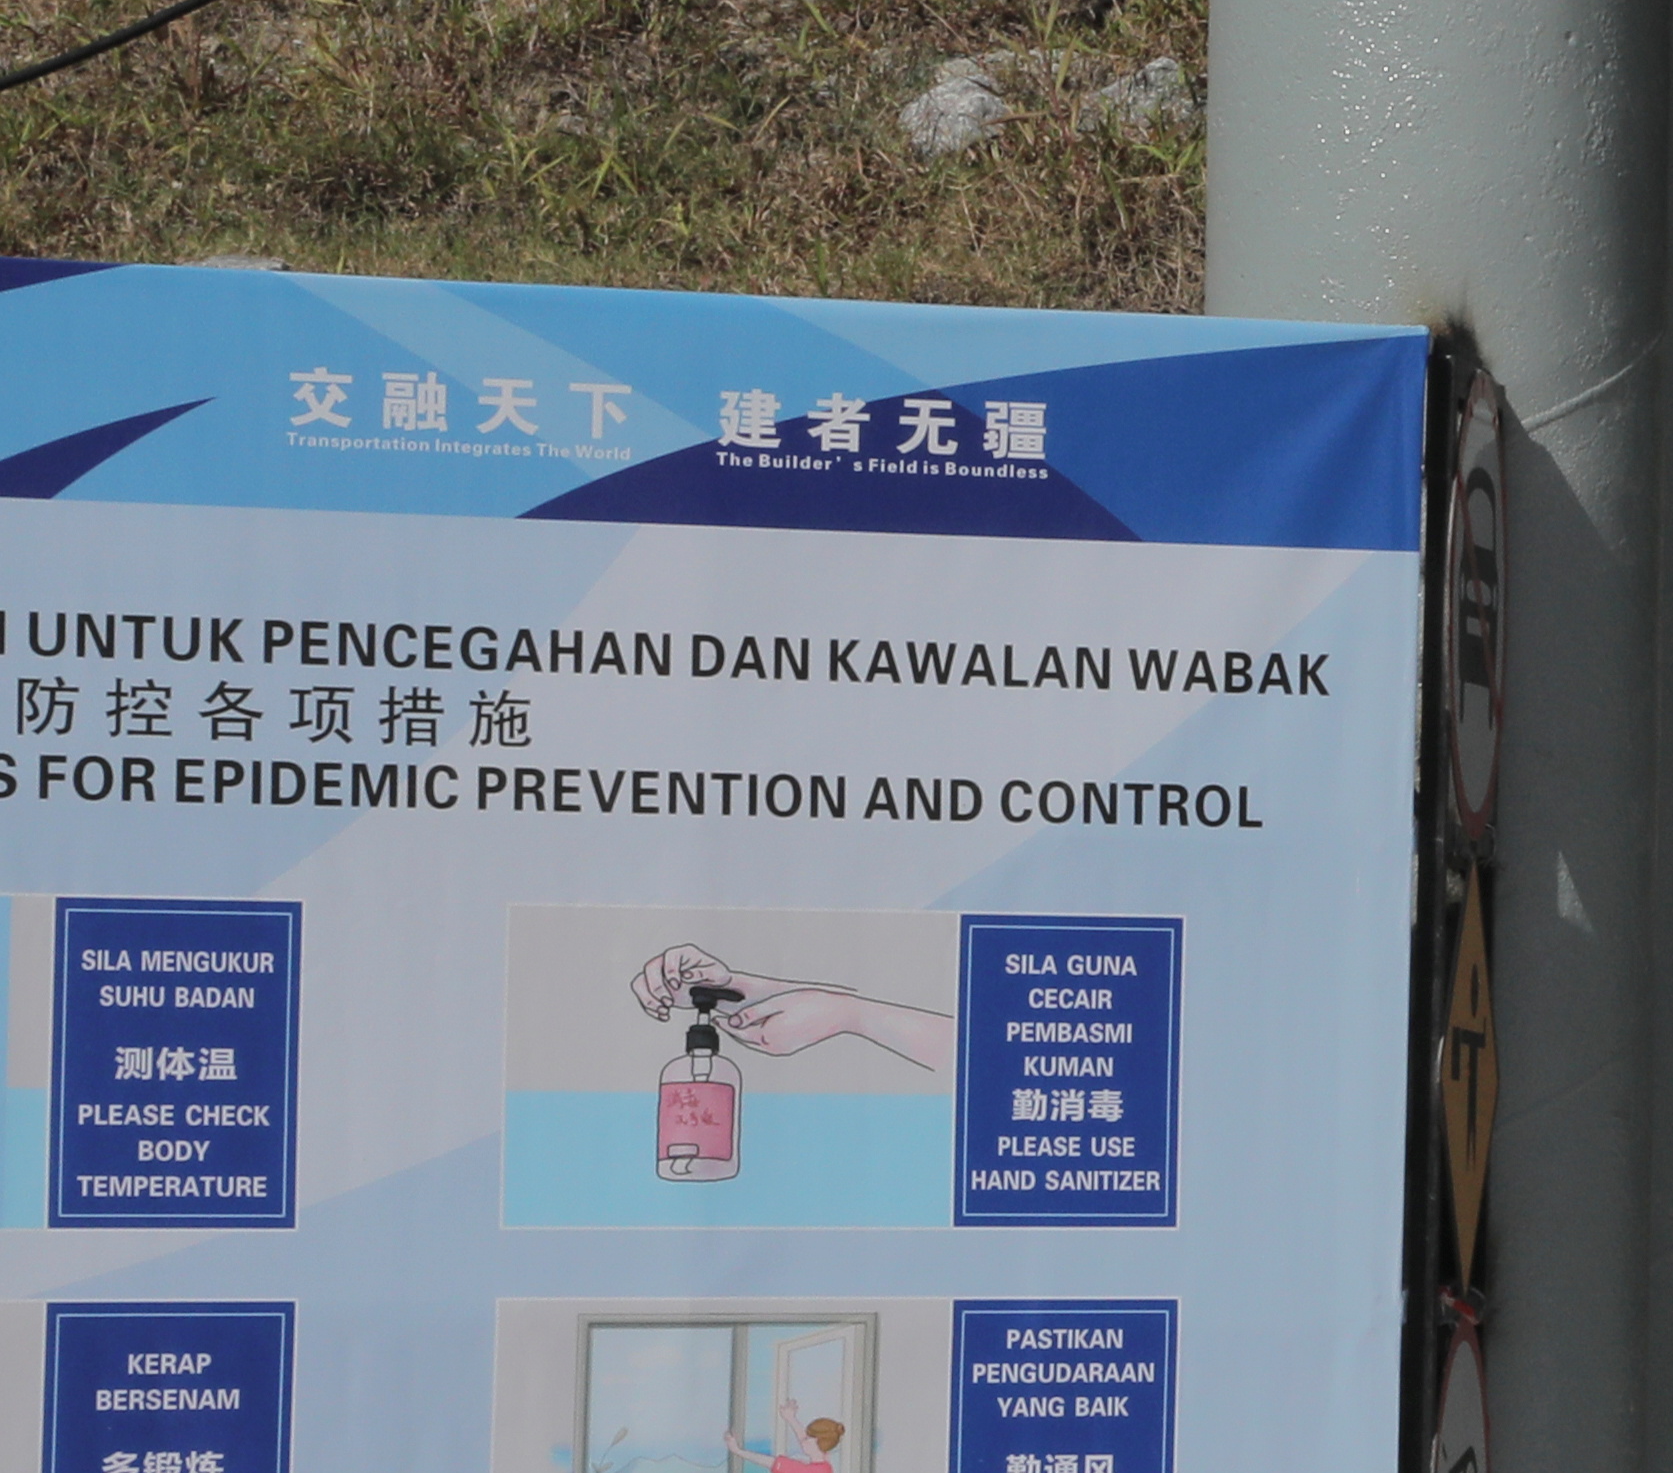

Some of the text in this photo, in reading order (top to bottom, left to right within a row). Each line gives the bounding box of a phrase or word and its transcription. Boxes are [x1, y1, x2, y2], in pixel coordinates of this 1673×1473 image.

[290, 367, 632, 439] 交融天下
[713, 382, 1052, 464] 建者无疆
[287, 432, 630, 460] Transportation Integrates The World
[716, 452, 753, 467] The
[869, 458, 917, 473] Field
[923, 461, 939, 474] is
[945, 462, 1048, 479] Boundless
[29, 612, 243, 662] UNTUK
[264, 620, 670, 675] PENCEGAHAN
[692, 635, 809, 680] DAN
[830, 640, 1110, 689] KAWALAN
[1129, 649, 1329, 695] WABAK
[18, 677, 531, 746] 防控各项措施
[40, 755, 1262, 827] FOR EPIDEMIC PREVENTION AND CONTROL
[82, 950, 274, 973] SILA MENGUKUR
[1006, 954, 1137, 975] SILA GUNA
[100, 985, 254, 1008] SUHU BADAN
[1029, 988, 1112, 1009] CECAIR
[1007, 1022, 1132, 1043] PEMBASMI
[115, 1047, 237, 1080] 测体温
[1024, 1056, 1113, 1077] KUMAN
[79, 1105, 269, 1126] PLEASE CHECK
[1012, 1089, 1123, 1122] 勤消毒
[139, 1140, 210, 1161] BODY
[998, 1137, 1135, 1157] PLEASE USE
[77, 1176, 267, 1197] TEMPERATURE
[972, 1170, 1160, 1190] HAND SANITIZER
[1007, 1329, 1123, 1349] PASTIKAN
[973, 1363, 1154, 1383] PENGUDARAAN
[997, 1395, 1130, 1420] YANG BAIK
